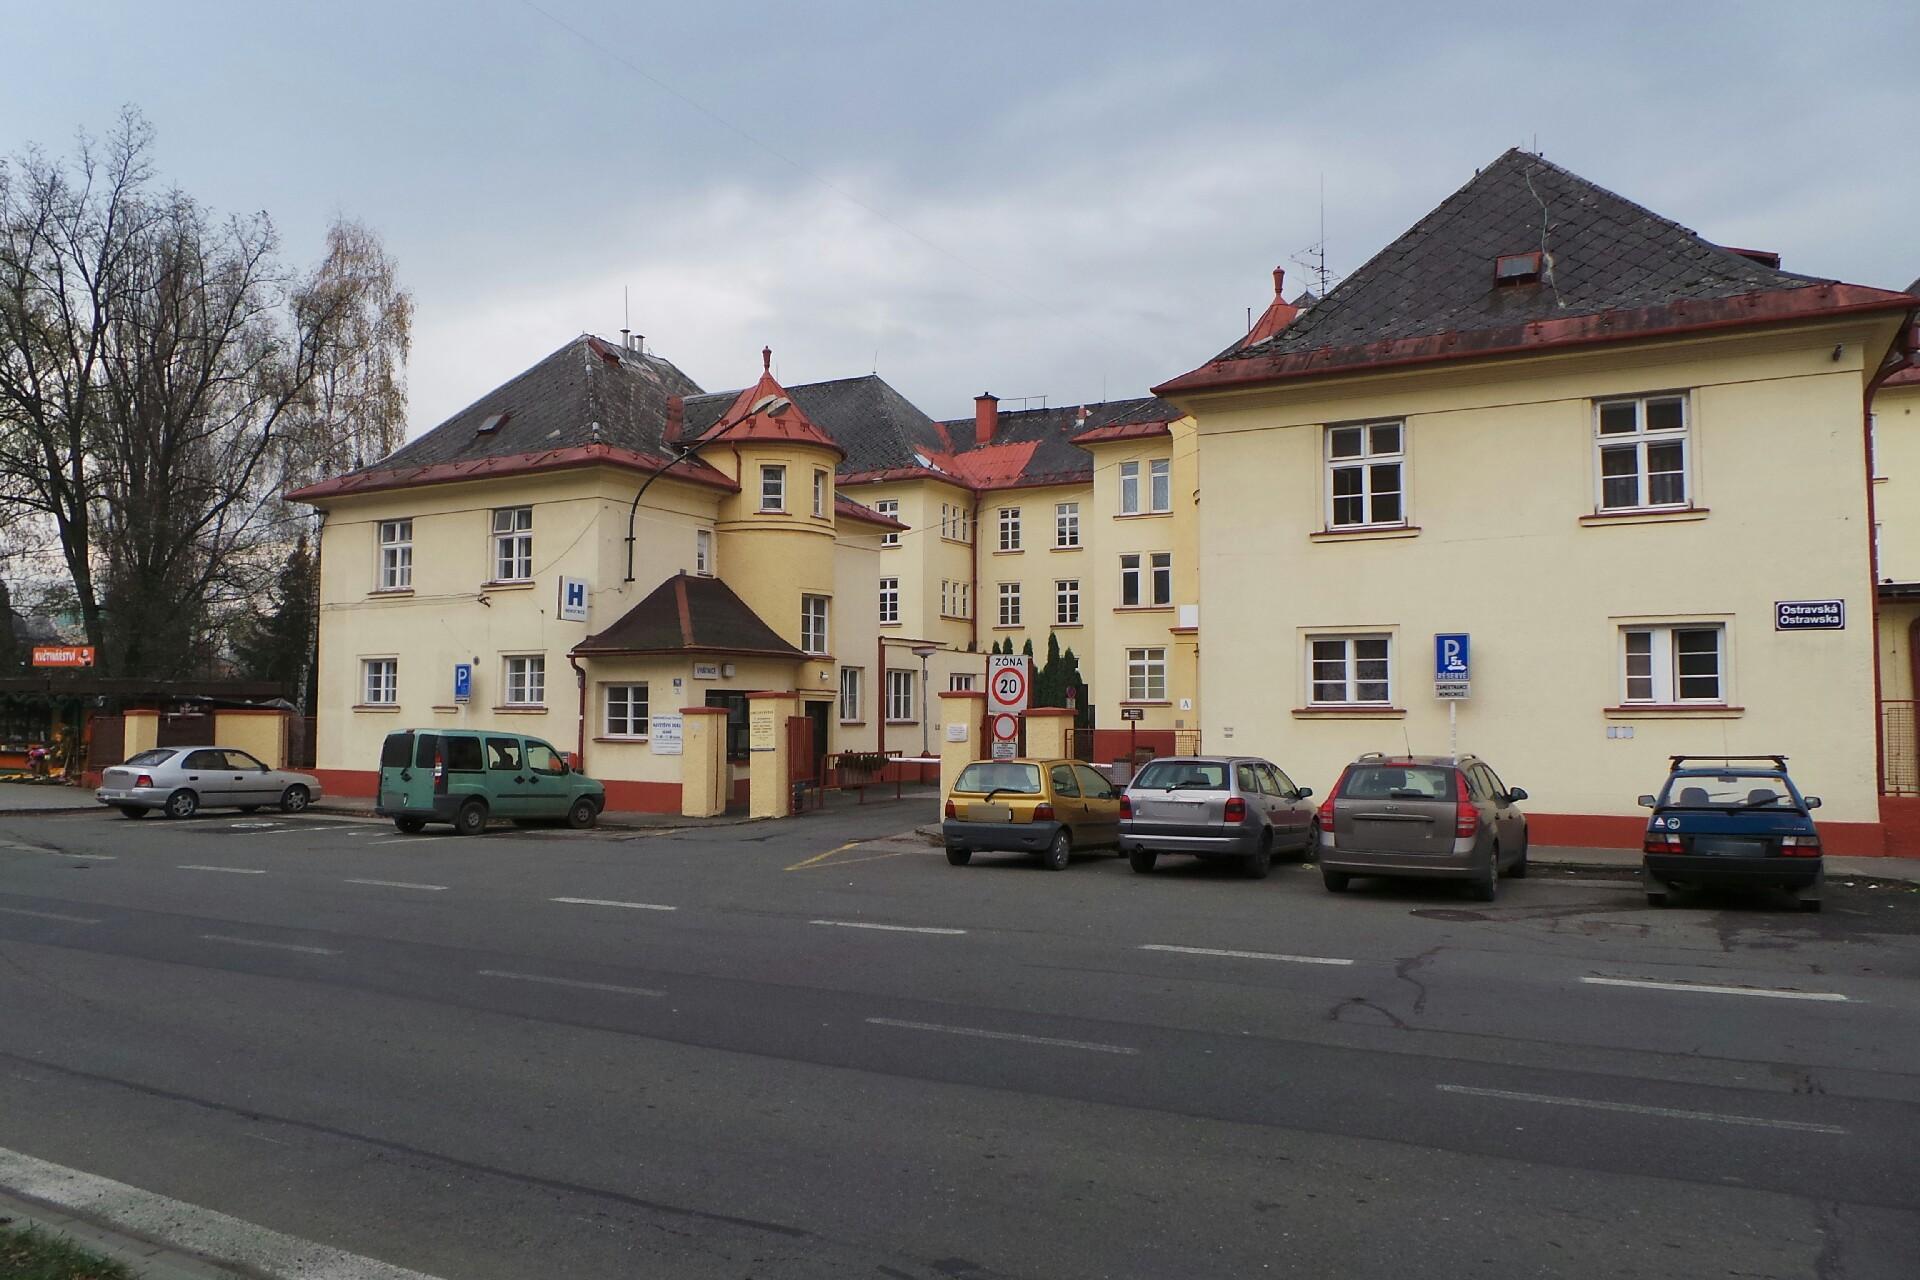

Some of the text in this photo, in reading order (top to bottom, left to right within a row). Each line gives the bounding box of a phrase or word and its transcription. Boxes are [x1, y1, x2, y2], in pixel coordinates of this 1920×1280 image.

[568, 583, 583, 607] H
[1781, 604, 1838, 615] Ostravská
[1780, 615, 1839, 624] Ostrawska
[1444, 639, 1460, 665] P
[995, 656, 1023, 666] ZÓNA
[457, 668, 467, 687] P
[1000, 679, 1017, 694] 20
